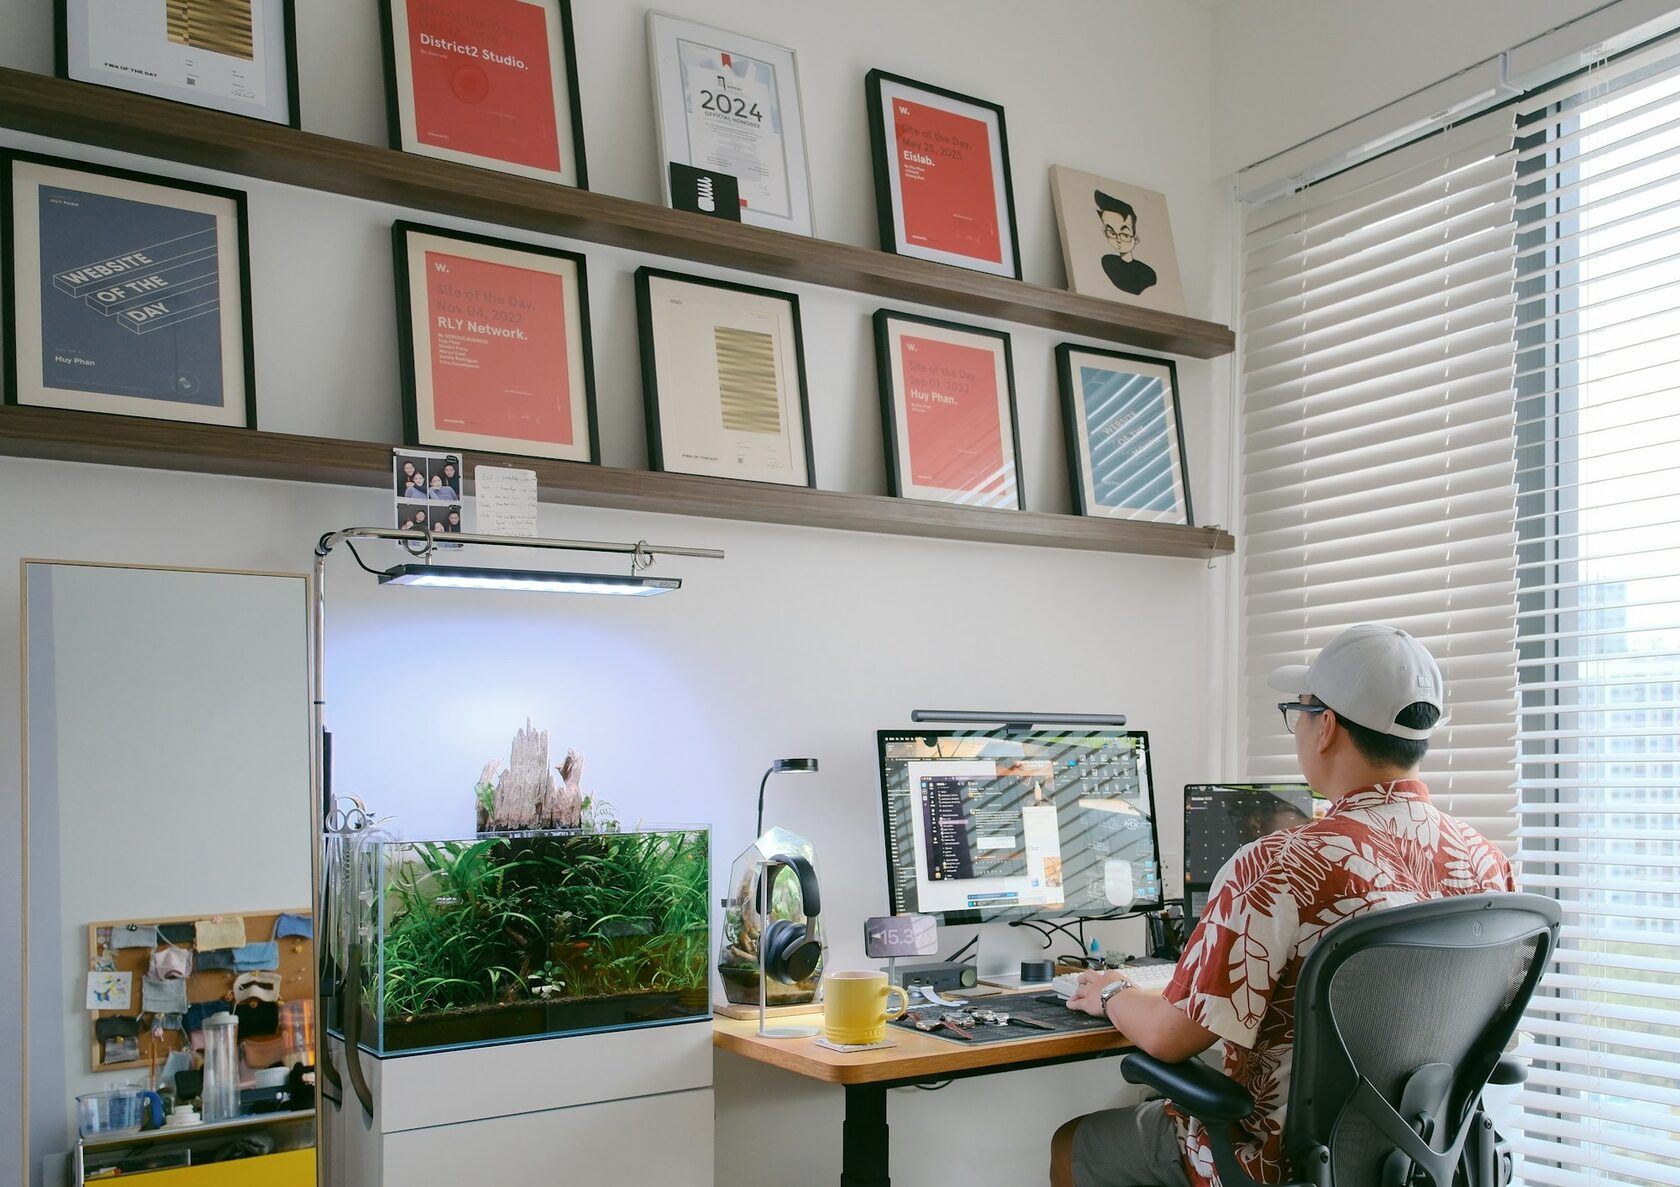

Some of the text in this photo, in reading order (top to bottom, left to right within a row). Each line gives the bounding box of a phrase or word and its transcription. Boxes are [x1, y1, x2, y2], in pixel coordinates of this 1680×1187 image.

[420, 33, 479, 58] District2
[482, 48, 529, 70] Studio.
[700, 89, 763, 123] 2024
[704, 110, 761, 130] OFFICIAL HONOREE
[903, 150, 936, 167] Eislab.
[62, 252, 153, 285] WEBSITE
[96, 274, 169, 302] OF THE
[466, 289, 481, 301] of
[483, 290, 505, 305] the
[126, 302, 170, 323] DAY
[436, 300, 463, 314] Nov
[438, 316, 528, 341] RLY Network.
[55, 355, 96, 366] Huy Phan
[910, 388, 958, 406] Huy Phan.
[1100, 410, 1137, 437] WEBSITE
